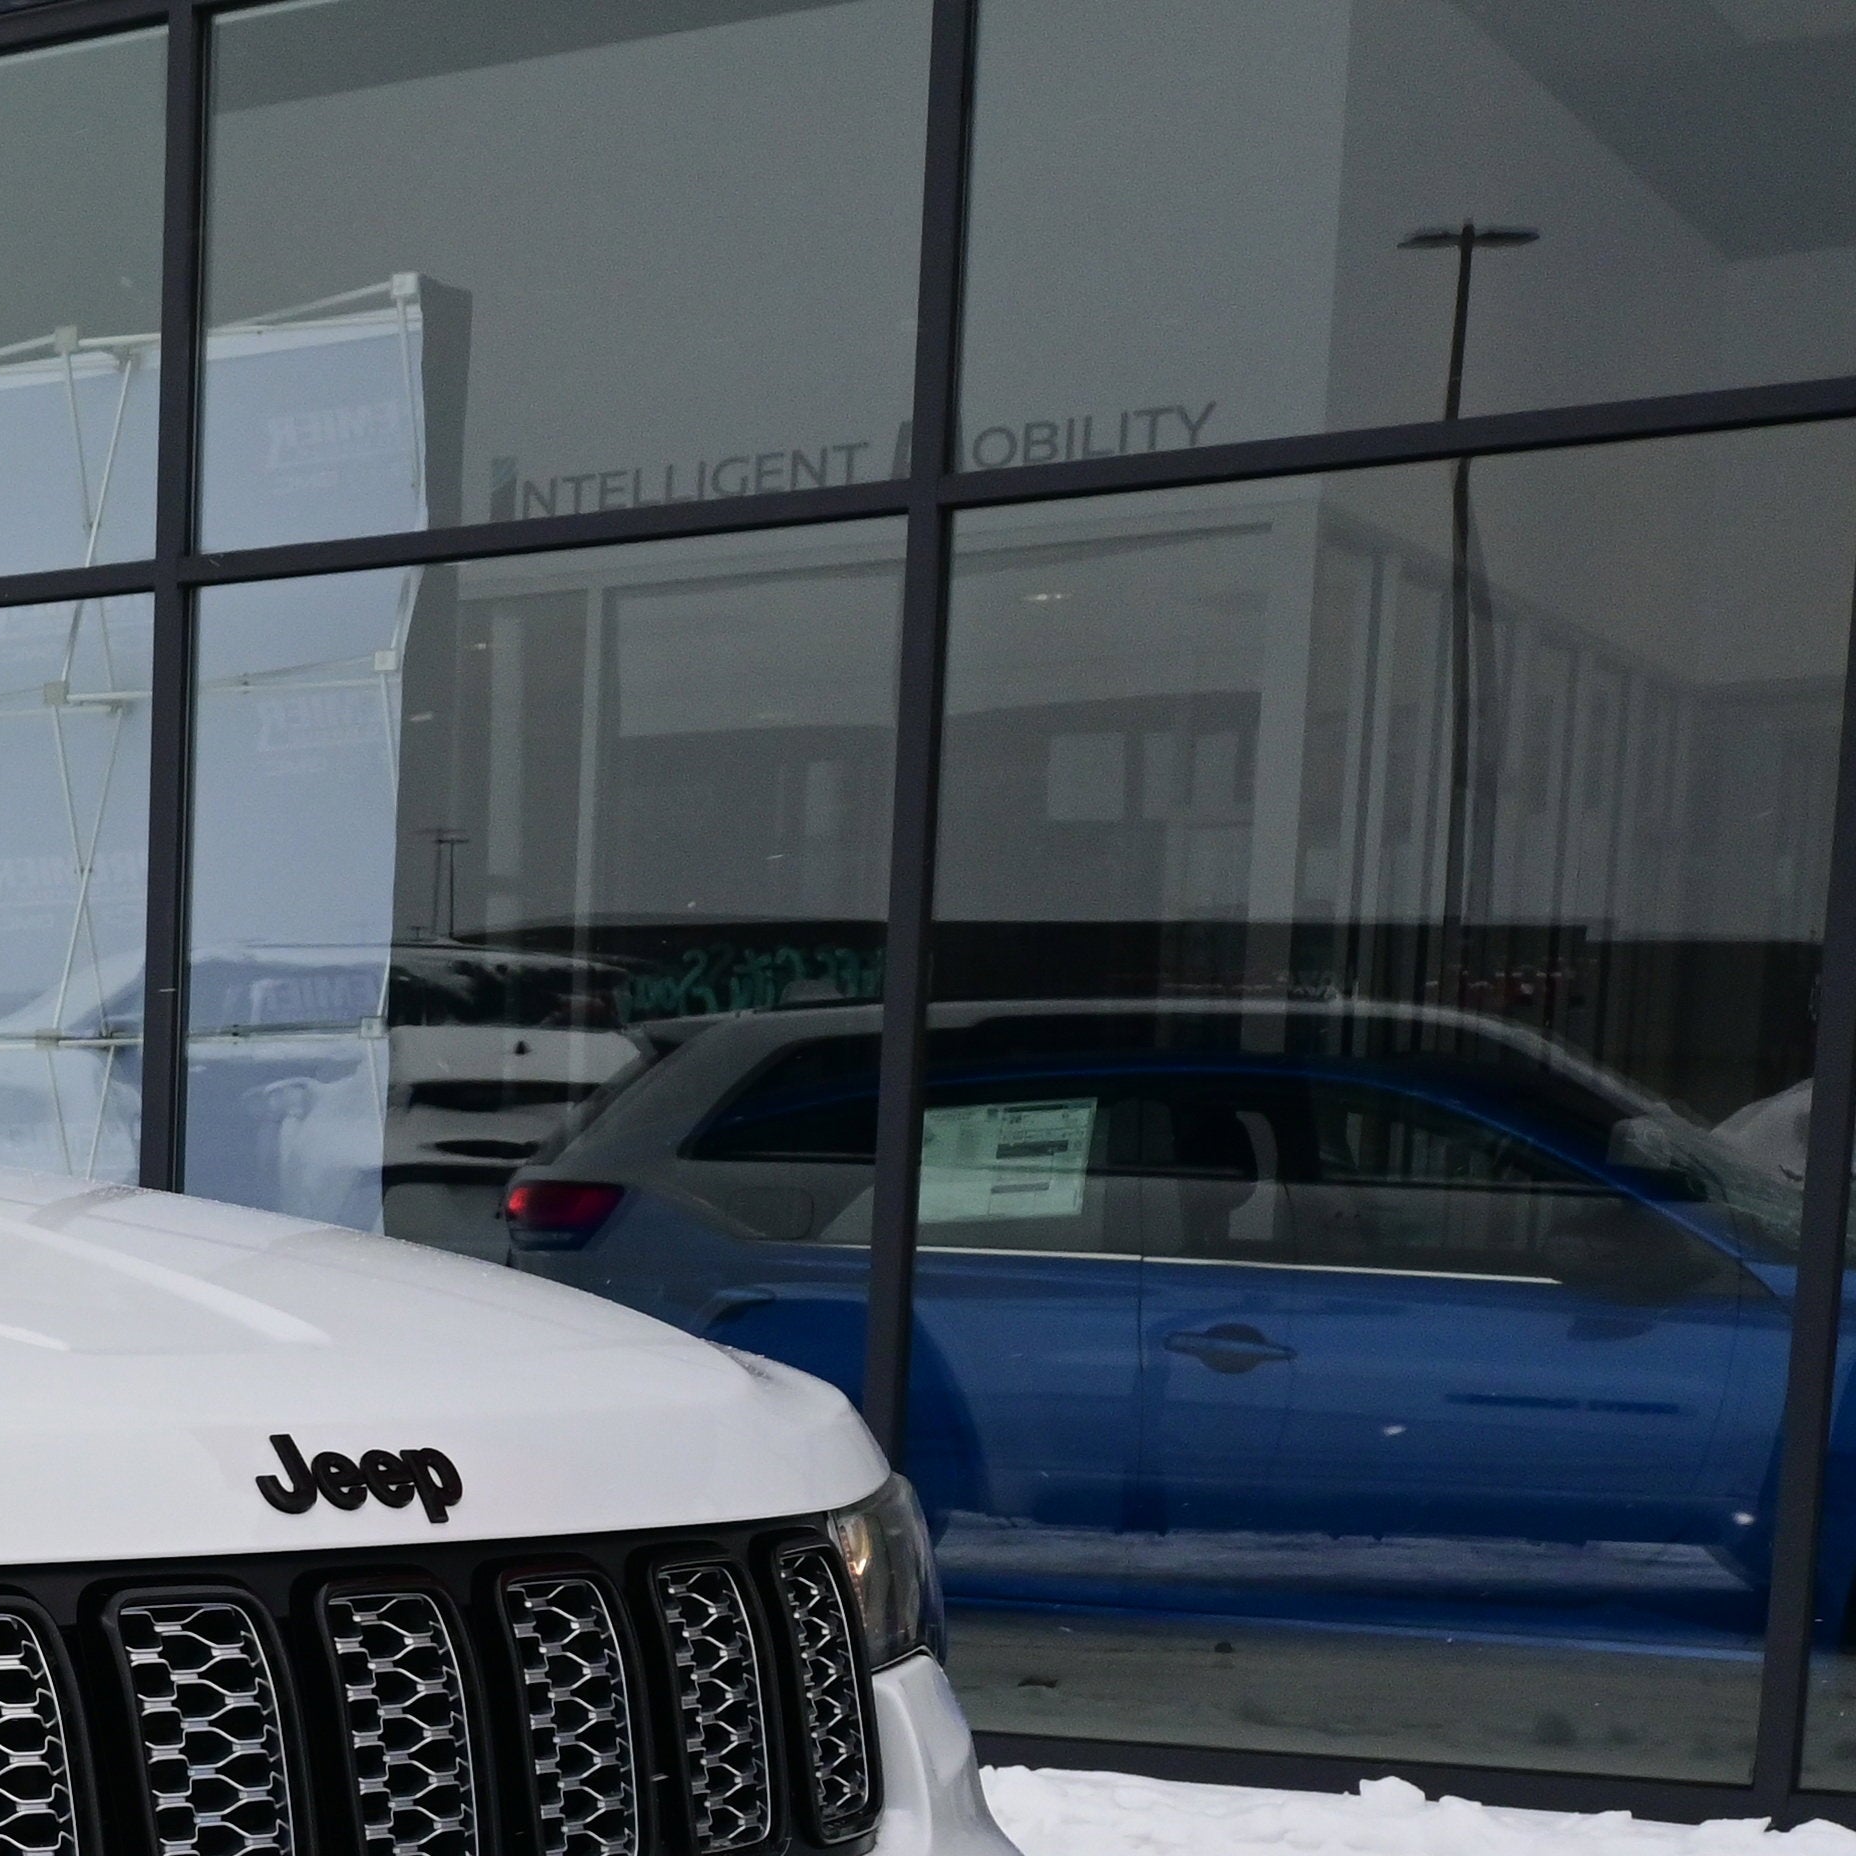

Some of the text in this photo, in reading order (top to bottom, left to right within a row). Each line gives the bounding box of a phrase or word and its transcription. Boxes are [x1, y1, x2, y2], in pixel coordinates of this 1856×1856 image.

[489, 401, 1217, 522] INTELLIGENT OBILITY
[255, 1434, 463, 1523] Jeep
